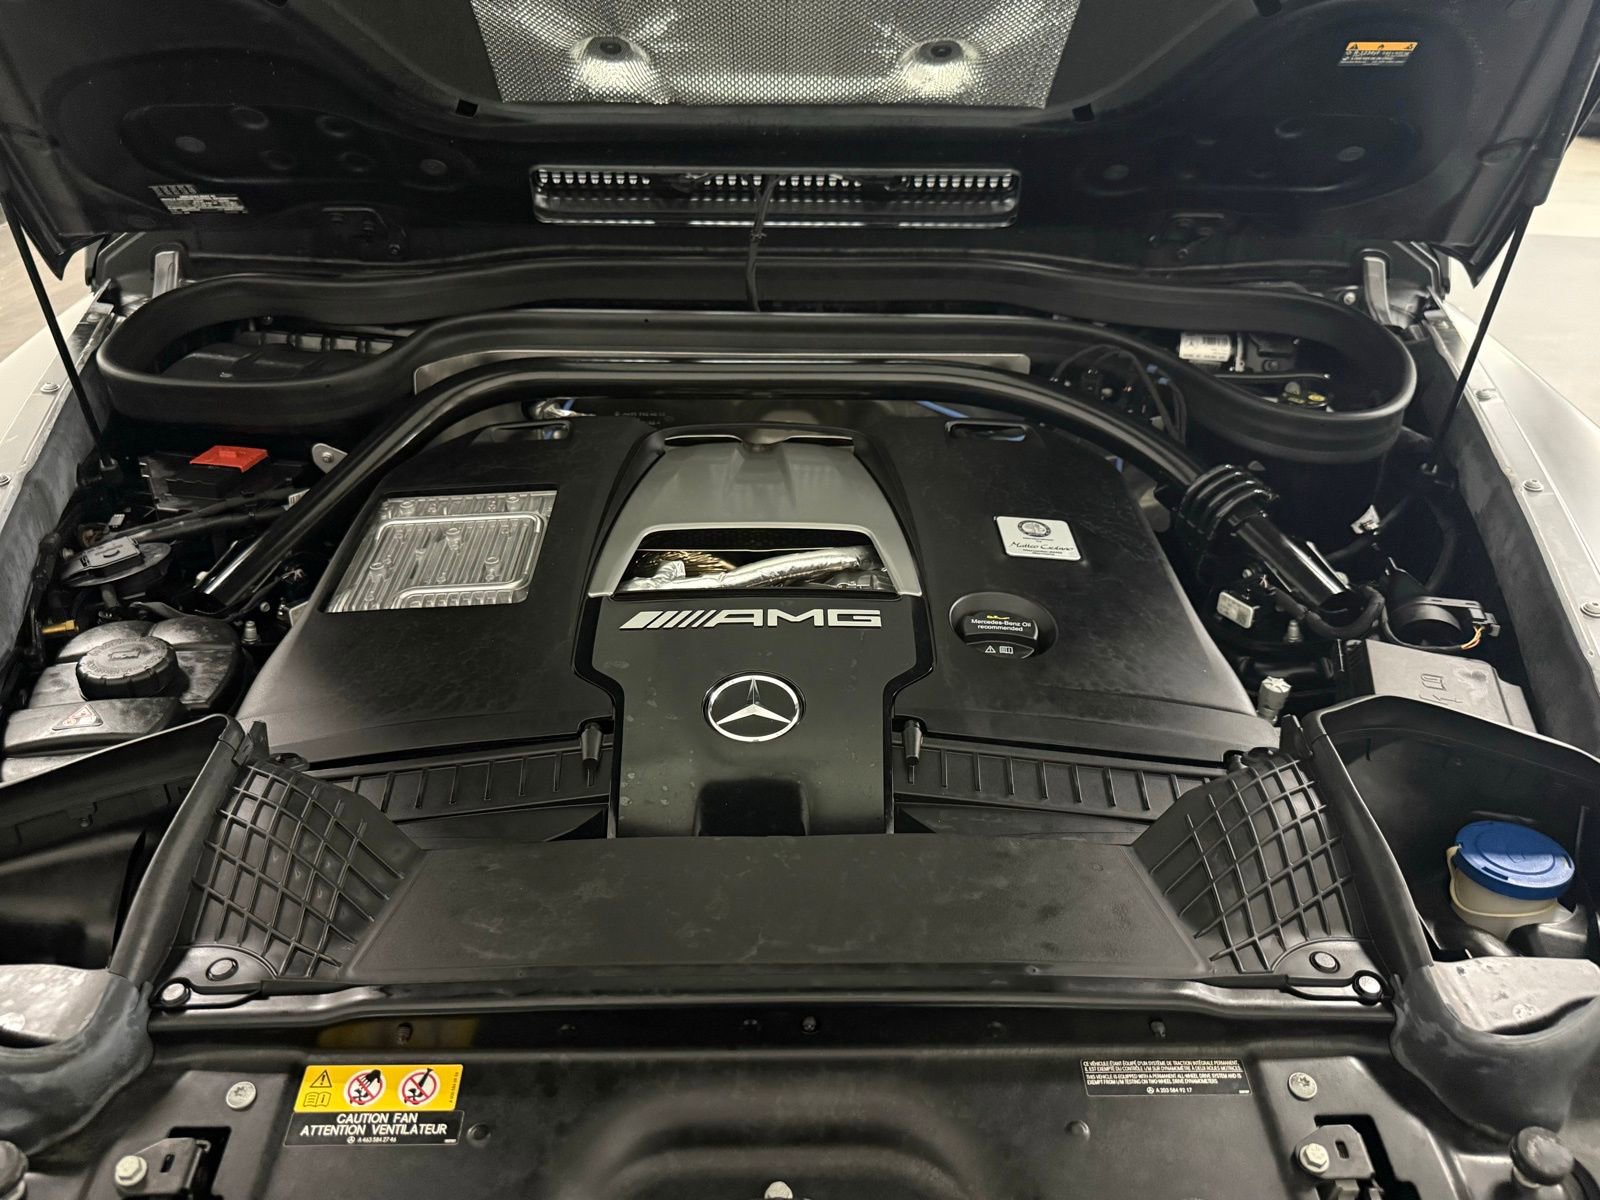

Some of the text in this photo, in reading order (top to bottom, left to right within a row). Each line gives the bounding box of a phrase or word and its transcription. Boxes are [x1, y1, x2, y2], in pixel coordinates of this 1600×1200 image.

[703, 609, 882, 627] AMG
[336, 1113, 418, 1124] CAUTION FAN
[300, 1124, 447, 1136] ATTENTION VENTILATEUR
